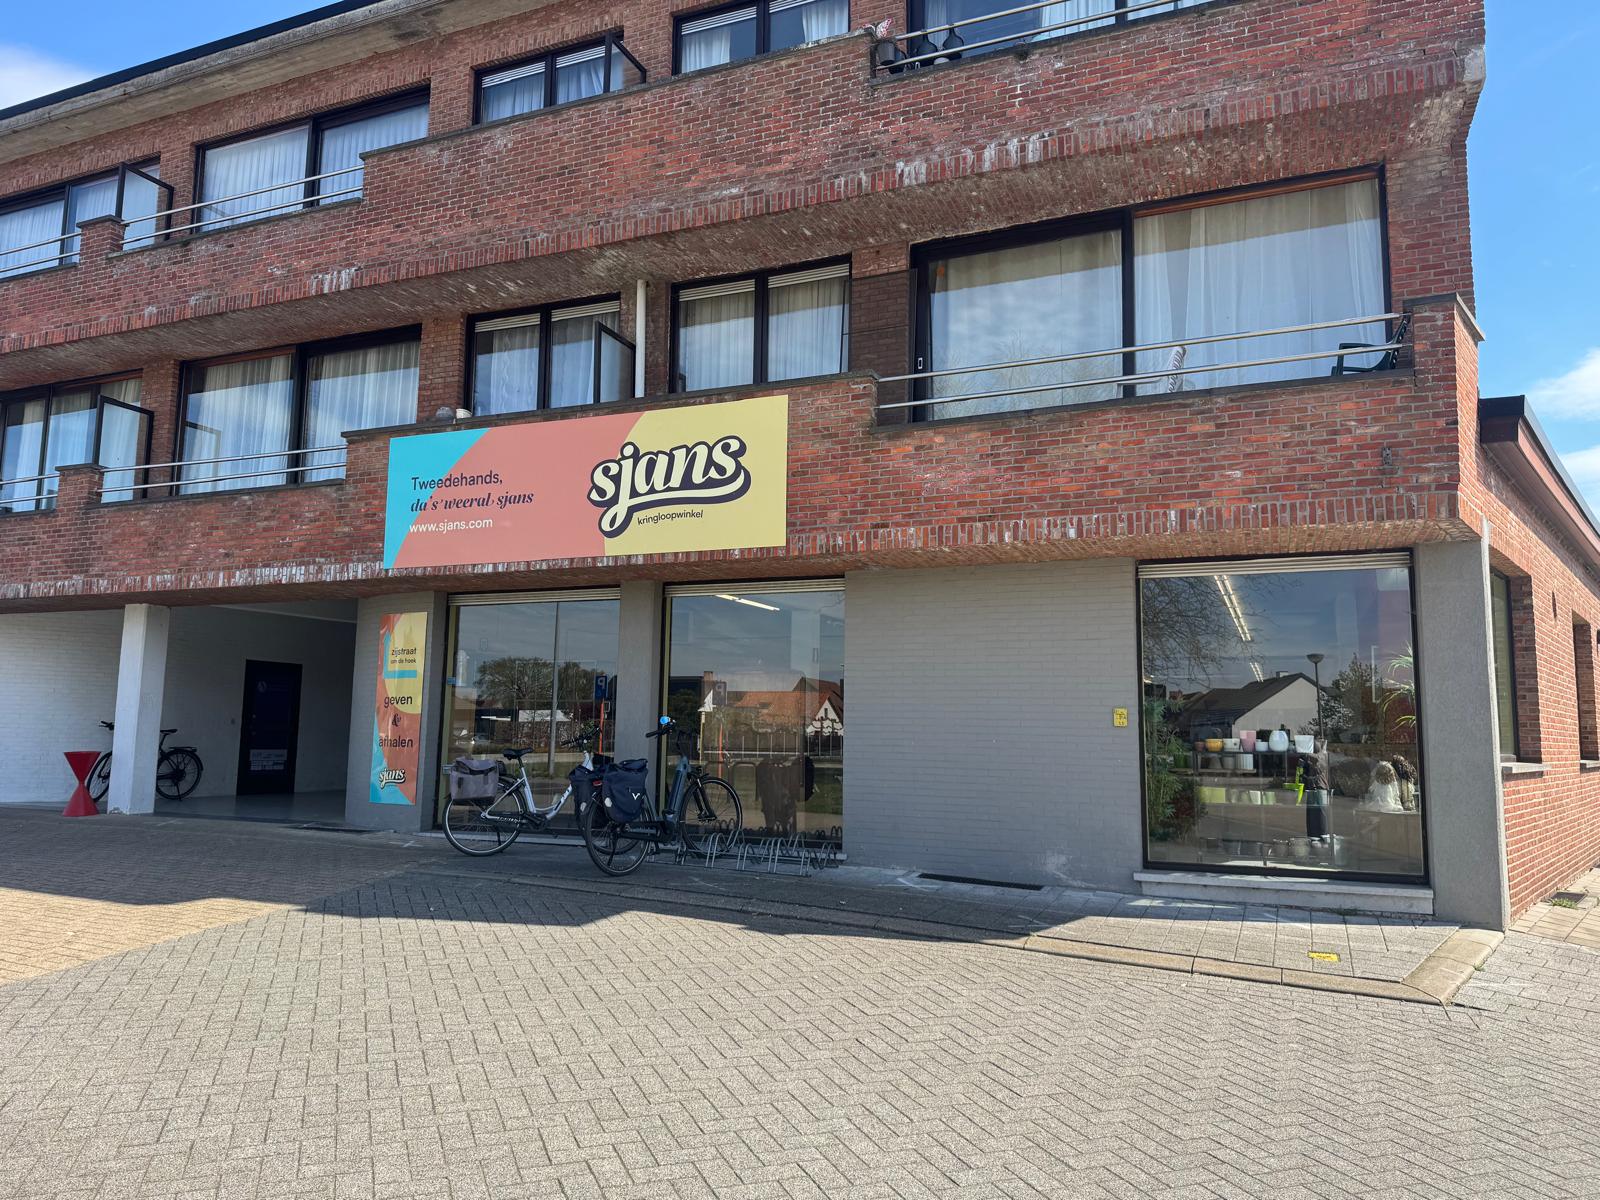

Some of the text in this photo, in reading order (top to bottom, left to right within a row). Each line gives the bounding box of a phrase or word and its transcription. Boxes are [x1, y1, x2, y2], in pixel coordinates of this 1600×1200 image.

[411, 469, 503, 491] Tweedehands,
[587, 435, 752, 539] sjans
[496, 491, 534, 509] sjans
[409, 518, 494, 534] www.sjans.com
[637, 509, 704, 526] kringloopwinkel
[384, 695, 413, 709] geven
[392, 713, 402, 727] &
[378, 735, 414, 748] afhalen
[379, 768, 406, 790] sjans
